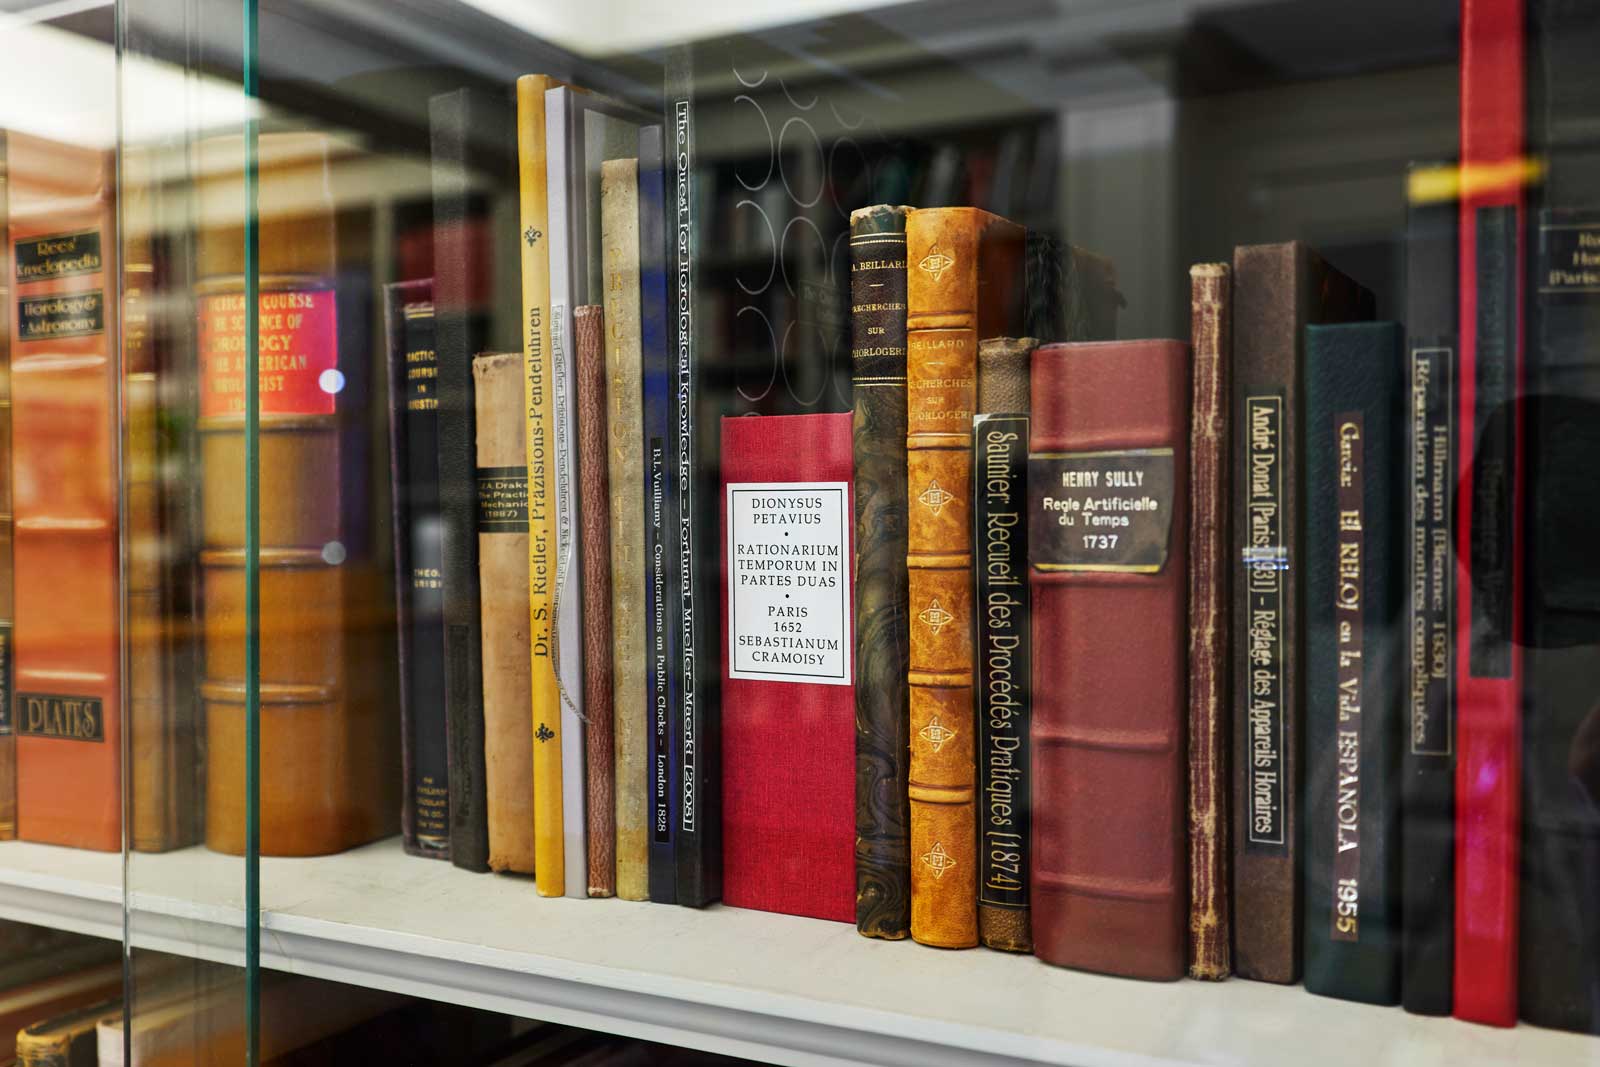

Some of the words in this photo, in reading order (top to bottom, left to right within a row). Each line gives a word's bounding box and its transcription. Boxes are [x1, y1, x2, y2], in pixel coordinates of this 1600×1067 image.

[677, 108, 688, 145] The
[679, 152, 688, 216] Quest
[680, 223, 689, 254] for
[261, 293, 314, 309] COURSE
[679, 260, 690, 375] Horological
[867, 327, 886, 336] SUR
[528, 307, 546, 521] Präzisions-Pendeluhren
[1252, 405, 1276, 450] André
[1413, 359, 1431, 478] Réparation
[679, 382, 690, 491] Knowledge
[1339, 422, 1360, 487] Garcia:
[986, 431, 1019, 505] Saunier:
[1062, 471, 1099, 487] HENRY
[1105, 471, 1144, 487] SULLY
[1252, 453, 1276, 497] Donat
[1433, 425, 1448, 521] Hillmann
[493, 491, 529, 499] Practi
[652, 448, 662, 529] B.L.Vuilliamy
[751, 498, 822, 509] DIONYSUS
[1043, 497, 1081, 513] Regle
[1083, 496, 1158, 511] Artificielle
[1415, 484, 1430, 521] des
[753, 513, 822, 525] PETAVIUS
[1058, 513, 1075, 526] du
[1081, 512, 1130, 528] Temps
[1340, 510, 1361, 531] El
[681, 517, 691, 600] Fortunat
[737, 544, 839, 556] RATIONARIUM
[986, 512, 1022, 586] Recueil
[1082, 535, 1119, 549] 1737
[532, 529, 548, 596] Riefler,
[738, 559, 816, 572] TEMPORUM
[822, 561, 838, 572] IN
[740, 575, 792, 587] PARTES
[797, 576, 836, 588] DUAS
[1337, 542, 1360, 612] RELOJ
[1415, 526, 1429, 611] montres
[654, 543, 665, 633] Considerations
[532, 603, 547, 621] S.
[767, 606, 809, 618] PARIS
[774, 622, 802, 633] 1652
[988, 592, 1022, 629] des
[533, 628, 548, 658] Dr.
[656, 636, 664, 651] on
[738, 635, 839, 651] SEBASTIANUM
[1250, 609, 1276, 666] Réglage
[1340, 621, 1351, 643] en
[656, 655, 666, 692] Public
[751, 651, 825, 666] CRAMOISY
[1339, 650, 1361, 667] la
[684, 607, 694, 755] Mueller-Maerki
[988, 635, 1023, 729] Procédés
[1253, 669, 1276, 696] des
[1339, 677, 1361, 721] Vida
[1413, 616, 1429, 745] compliquées
[28, 698, 96, 738] PLATES
[657, 696, 667, 736] Clocks
[1250, 699, 1277, 767] Appareils
[657, 754, 667, 798] London
[684, 763, 694, 824] [2008]
[986, 735, 1022, 825] Pratiques
[1338, 731, 1359, 853] ESPANOLA
[657, 802, 667, 832] 1828
[1253, 770, 1277, 834] Horaires
[1337, 878, 1358, 934] 1955
